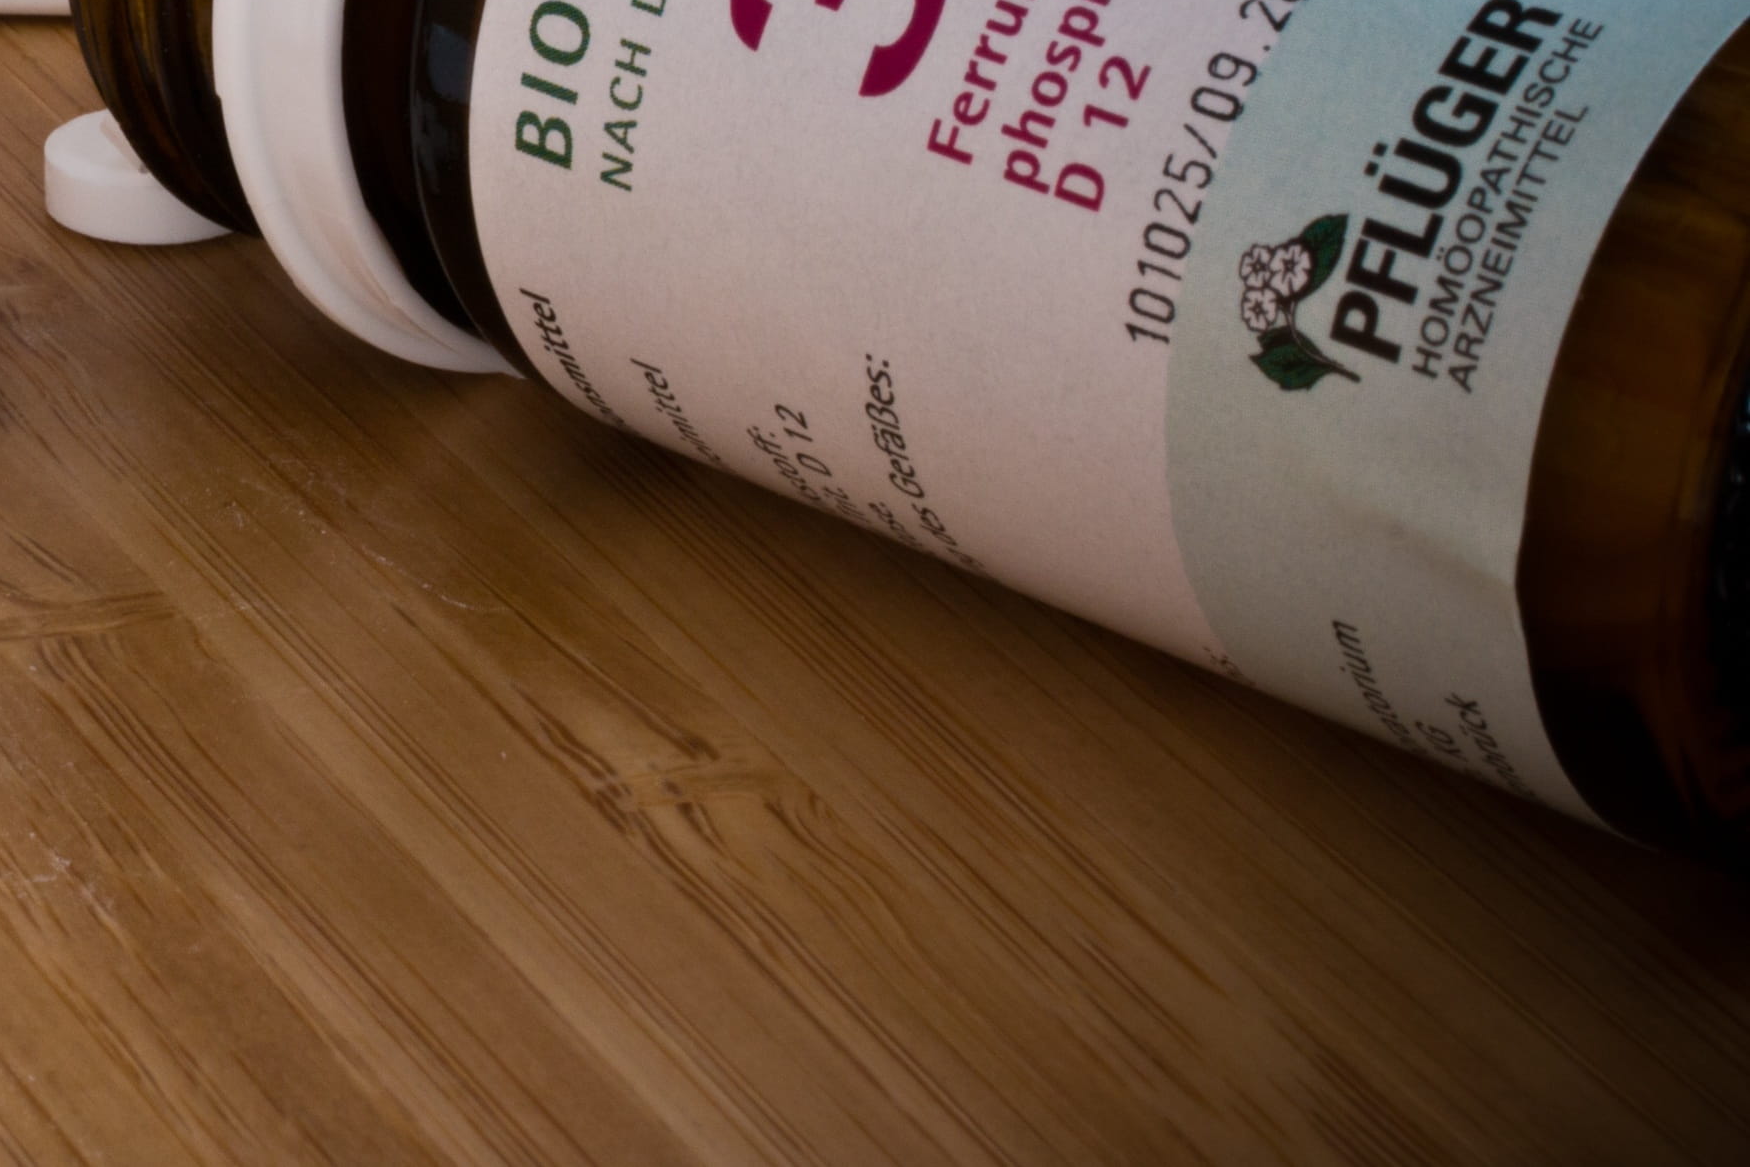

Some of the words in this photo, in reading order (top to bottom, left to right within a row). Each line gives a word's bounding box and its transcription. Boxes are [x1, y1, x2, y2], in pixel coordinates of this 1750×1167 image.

[598, 37, 653, 192] NACH
[1079, 55, 1154, 133] 12
[1052, 162, 1107, 213] D
[1410, 16, 1606, 380] HOMÖOPATHISCHE
[1447, 102, 1591, 396] ARZNEIMITTEL
[773, 403, 814, 443] 12
[862, 352, 926, 500] Gefäßes:
[911, 502, 959, 548] des
